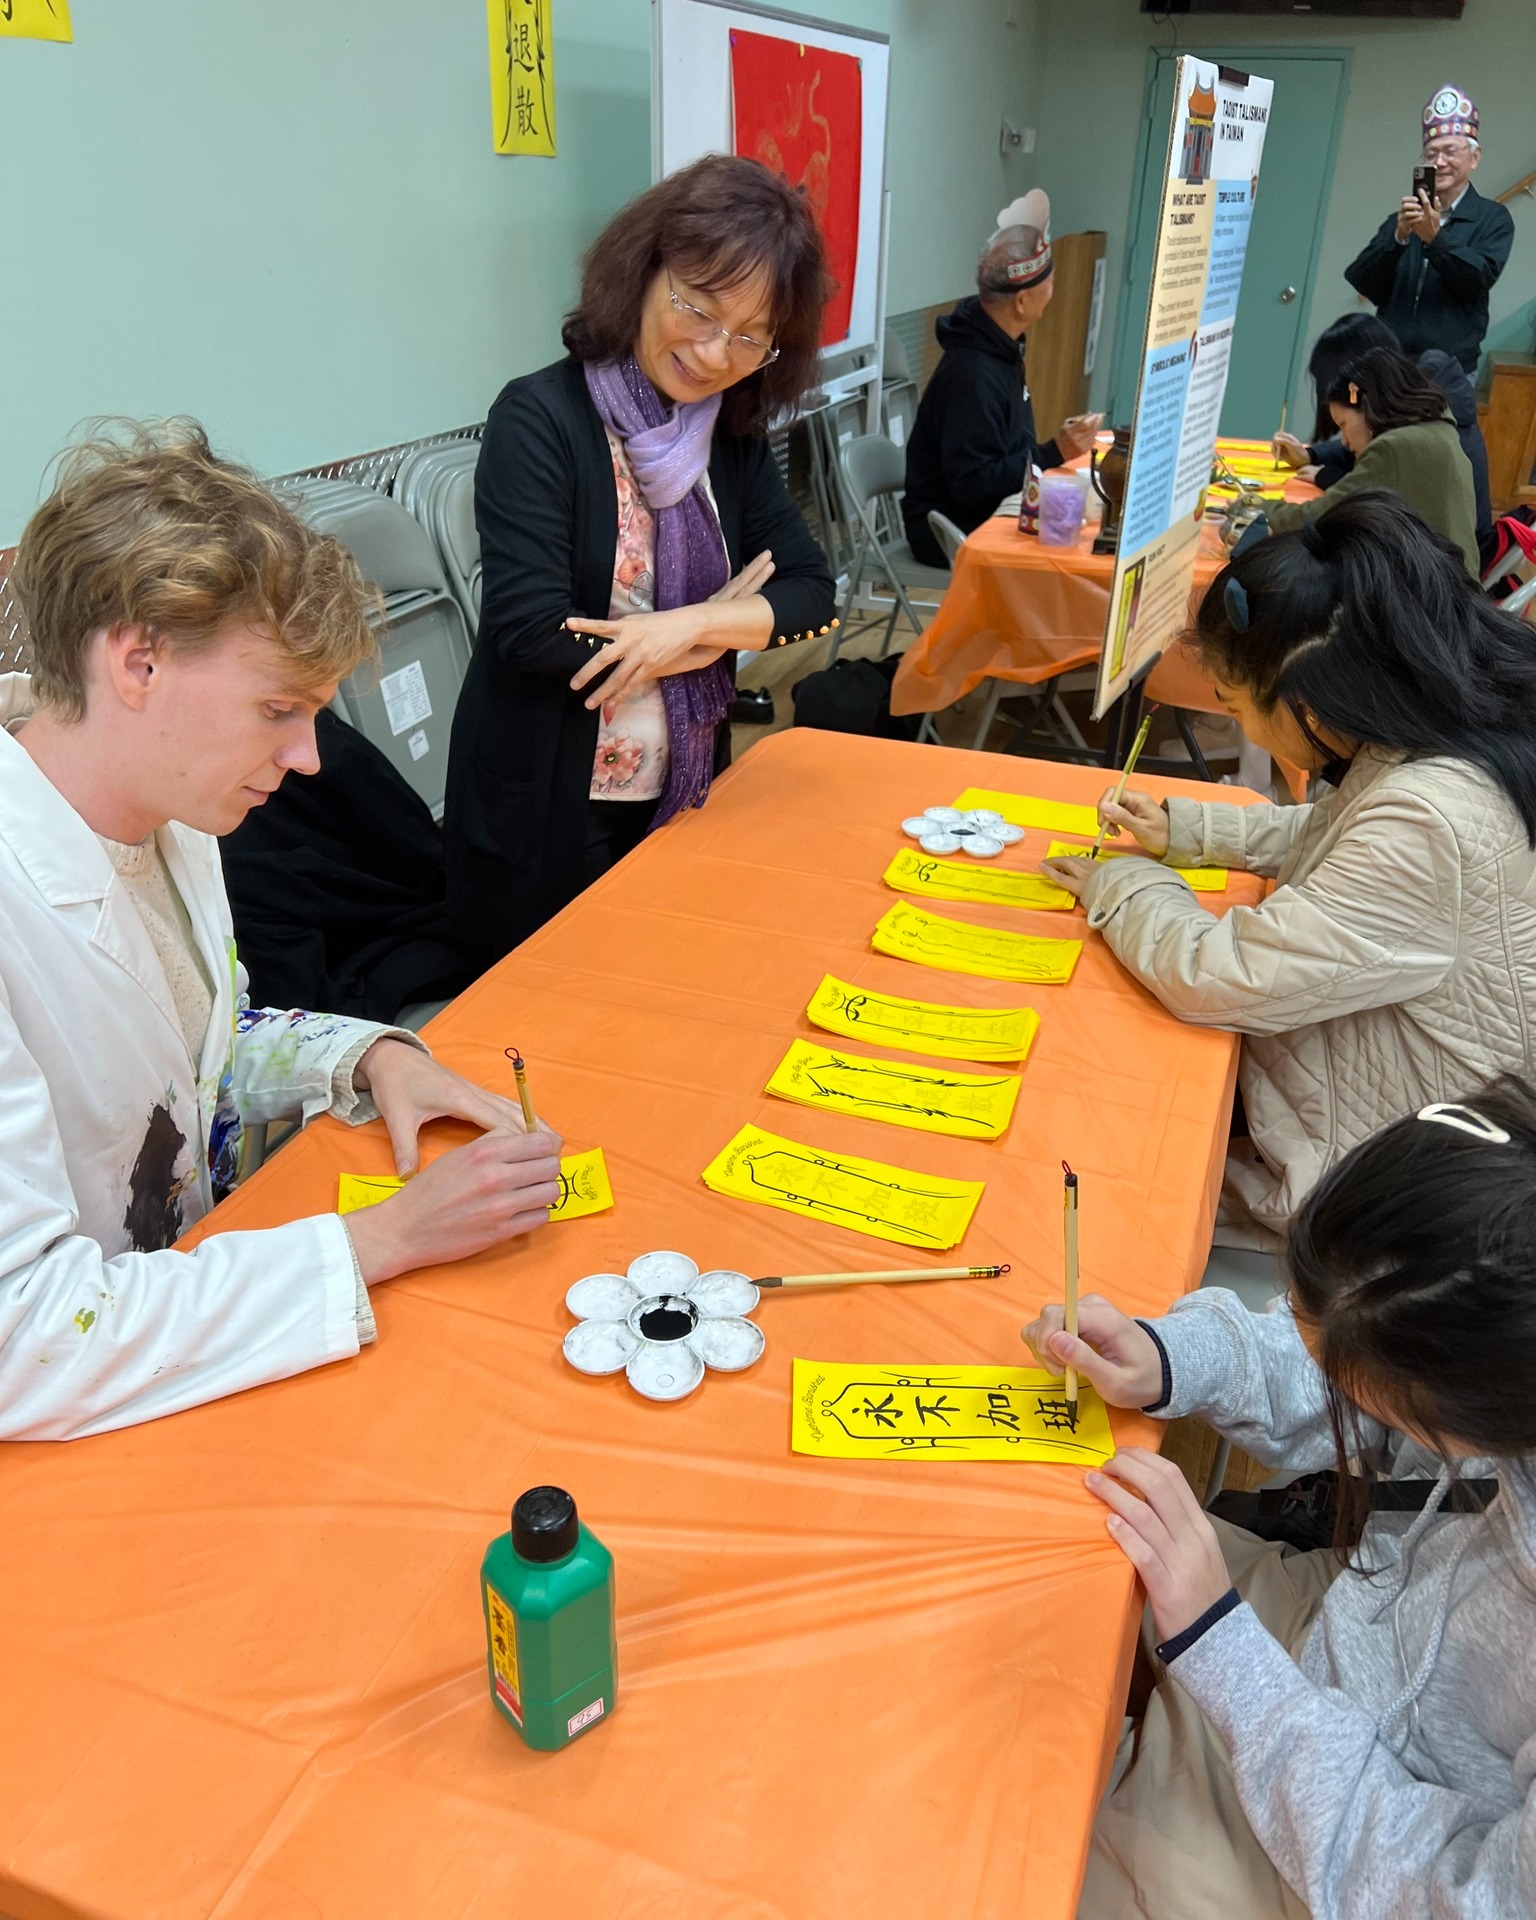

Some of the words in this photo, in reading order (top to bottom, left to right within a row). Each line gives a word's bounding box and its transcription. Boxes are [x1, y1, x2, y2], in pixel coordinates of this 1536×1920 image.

[513, 0, 538, 136] 退散
[1223, 99, 1239, 119] TAOIST
[1219, 123, 1225, 140] IN
[1225, 123, 1244, 141] TAIWAN
[764, 1162, 941, 1226] 永不加班
[801, 1374, 826, 1407] Banished
[804, 1407, 825, 1442] Overtime
[852, 1392, 1080, 1434] 永不加班
